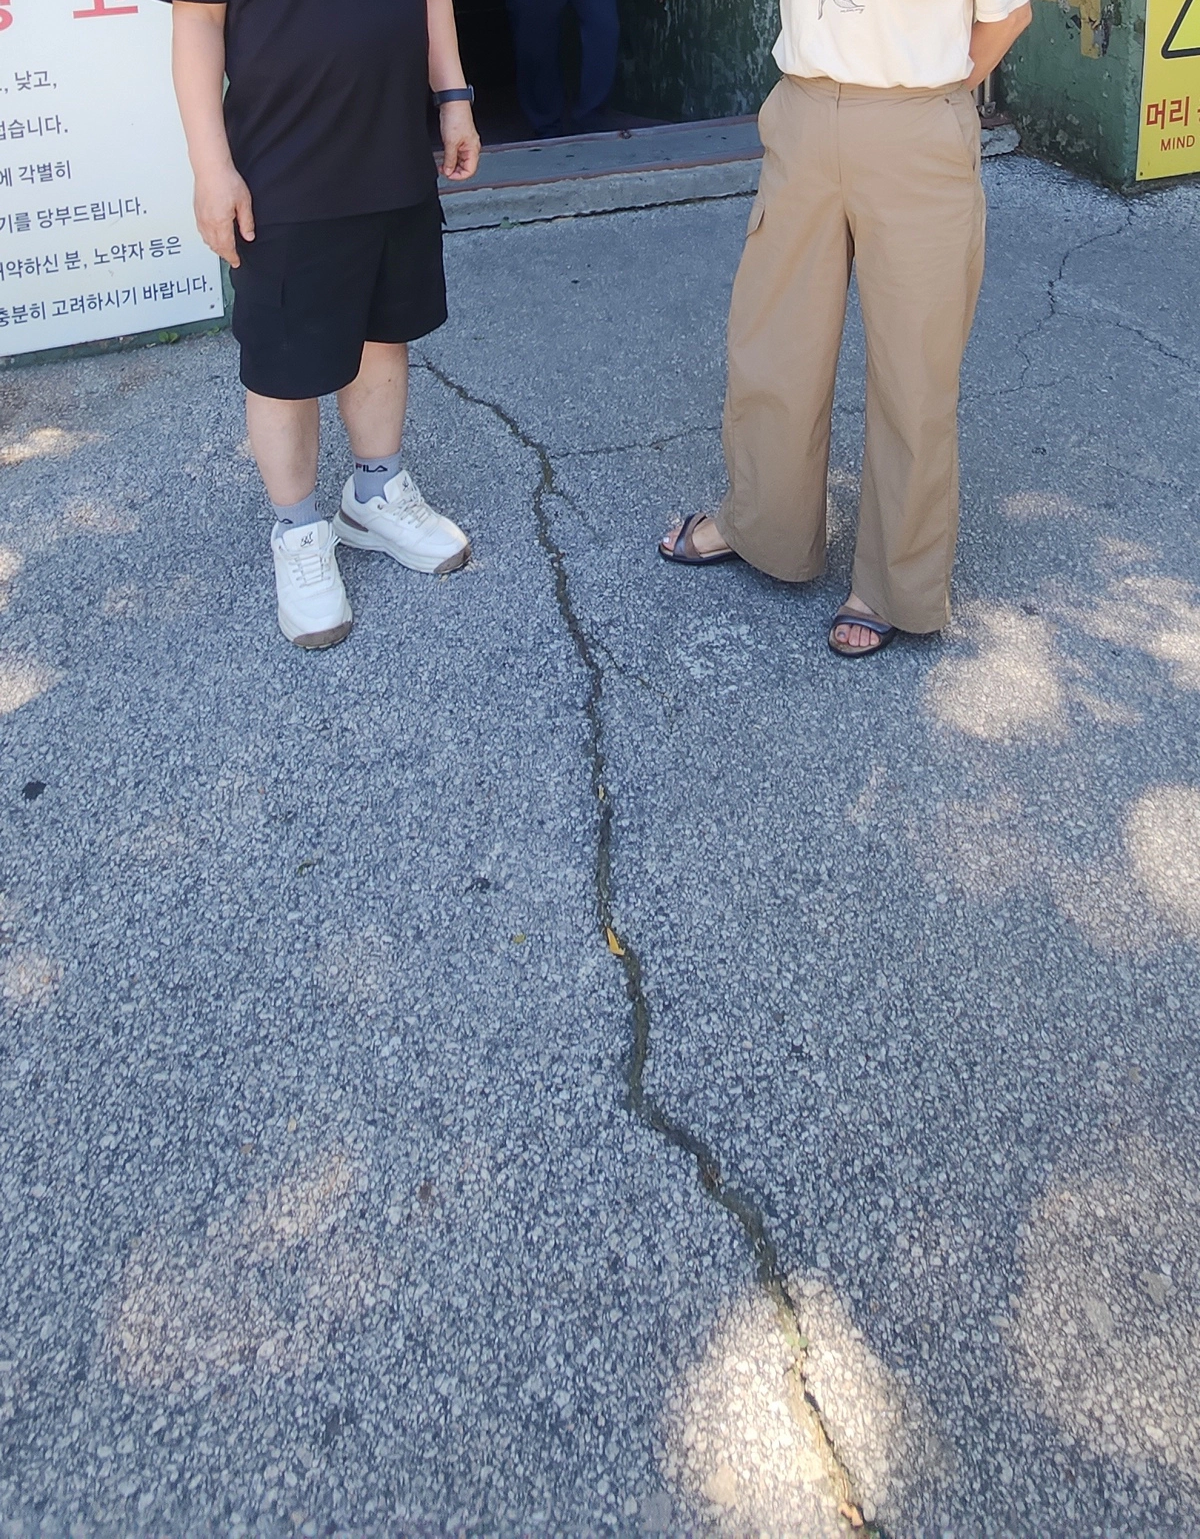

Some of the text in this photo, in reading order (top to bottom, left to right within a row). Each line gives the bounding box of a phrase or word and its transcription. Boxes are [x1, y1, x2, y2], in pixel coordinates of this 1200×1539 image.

[14, 70, 57, 92] 낮고,
[1146, 96, 1190, 130] 머리
[1160, 135, 1196, 152] MIND
[18, 160, 71, 184] 각별히
[37, 196, 147, 229] 당부드립니다.
[64, 250, 88, 271] 분,
[93, 241, 144, 265] 노약자
[149, 236, 182, 258] 등은
[51, 286, 138, 317] 고려하시기
[143, 275, 213, 302] 바랍니다.
[355, 462, 388, 473] FILA
